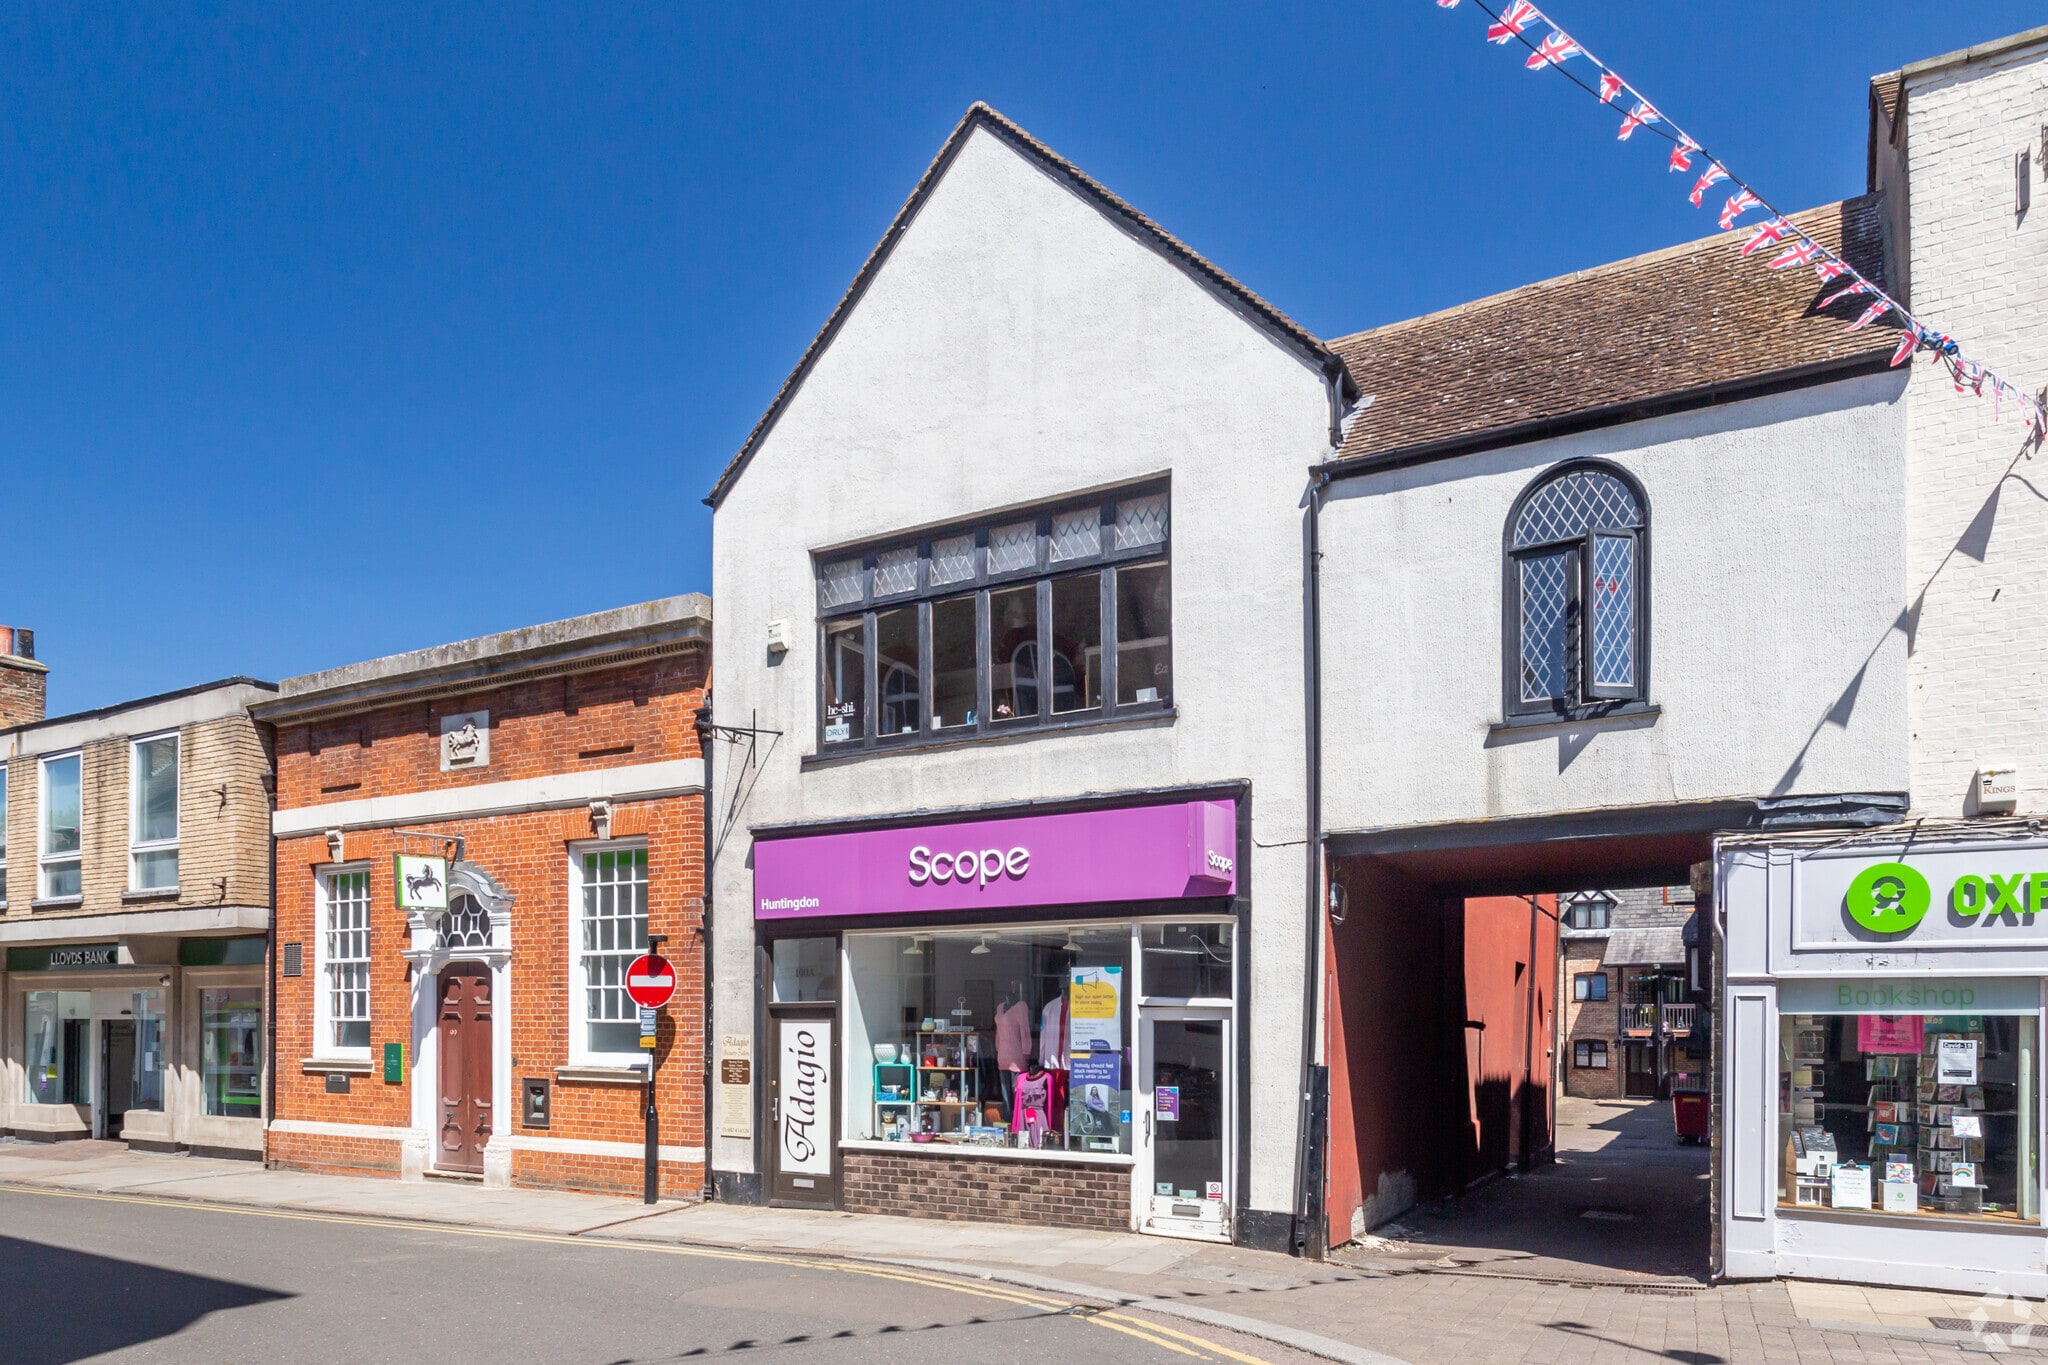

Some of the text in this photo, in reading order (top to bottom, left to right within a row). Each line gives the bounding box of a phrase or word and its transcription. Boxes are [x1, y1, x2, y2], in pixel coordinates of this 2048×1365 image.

[908, 845, 1030, 886] Scope
[1208, 849, 1233, 872] Scope
[761, 896, 820, 911] Huntingdon
[1953, 872, 2048, 916] OXF
[50, 950, 110, 965] LLOYDS BANK
[1837, 984, 1976, 1010] Bookshop
[784, 1030, 827, 1163] Adagio
